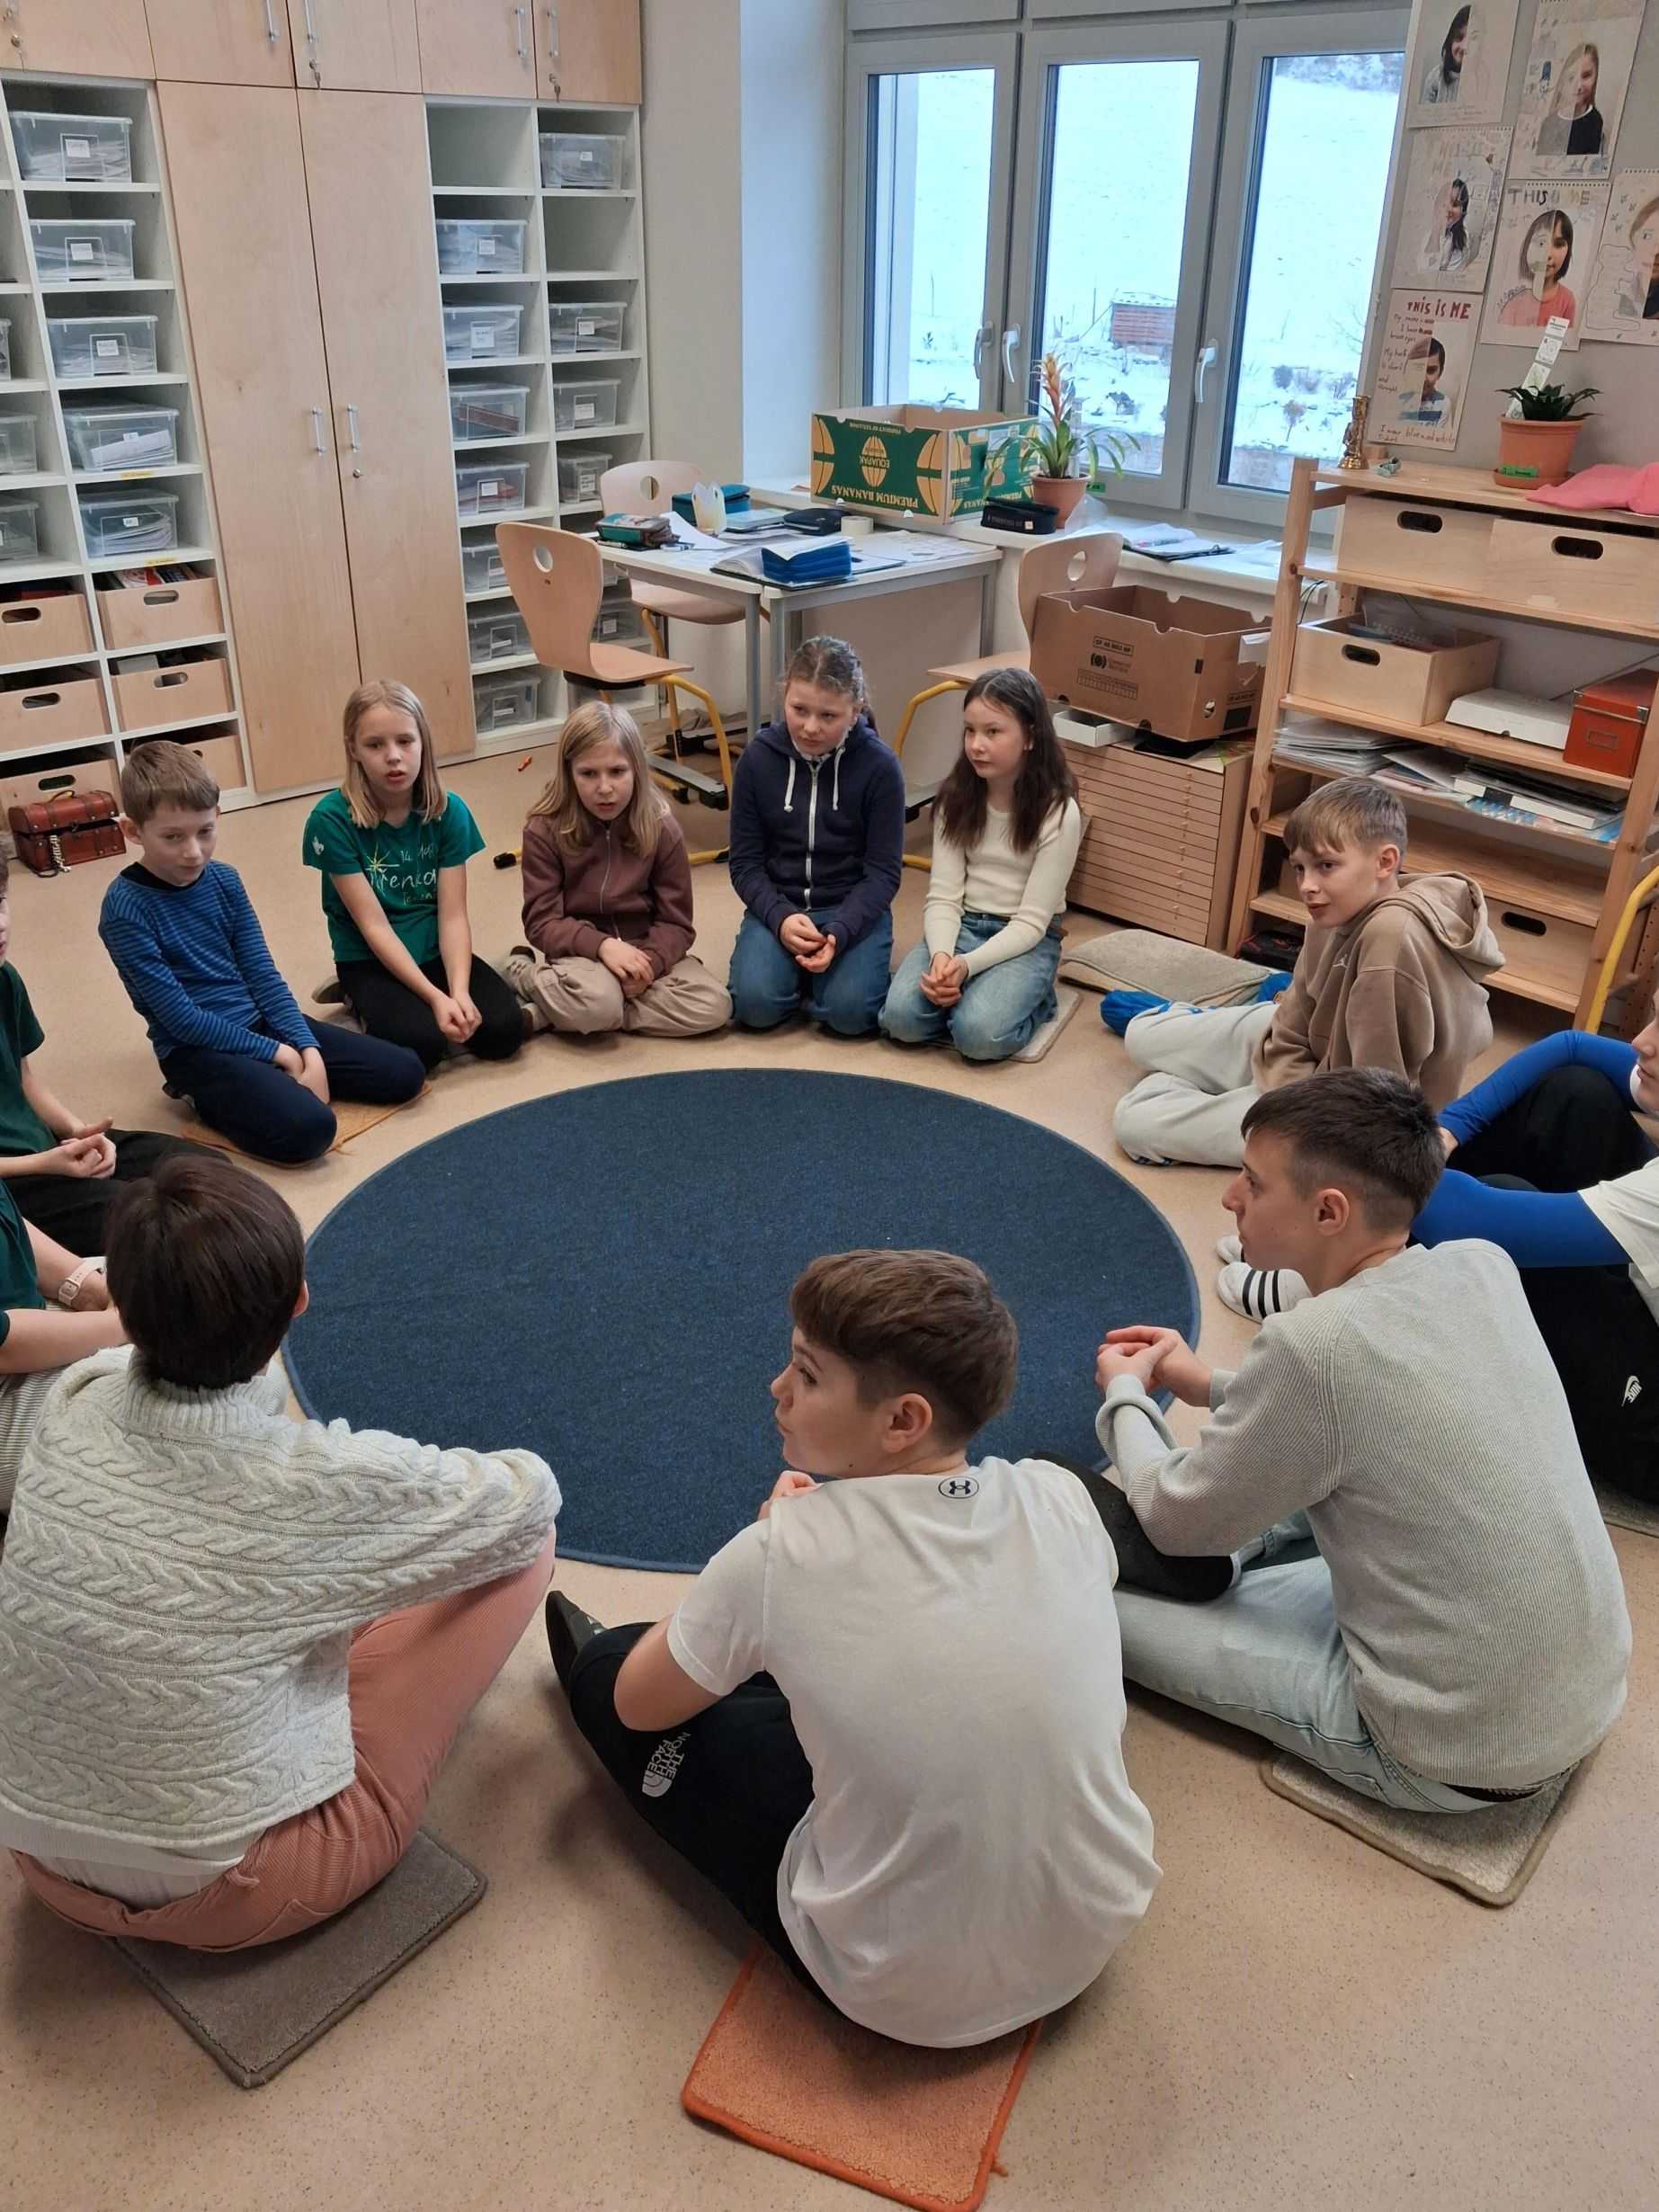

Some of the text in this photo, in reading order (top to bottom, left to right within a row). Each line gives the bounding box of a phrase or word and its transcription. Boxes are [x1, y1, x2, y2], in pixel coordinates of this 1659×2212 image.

[1507, 187, 1548, 207] THIS
[1449, 302, 1471, 319] ME
[831, 486, 918, 508] PREMIUM BANANAS
[647, 1739, 670, 1771] FACE
[656, 1732, 691, 1776] NORTH
[665, 1753, 684, 1779] THE
